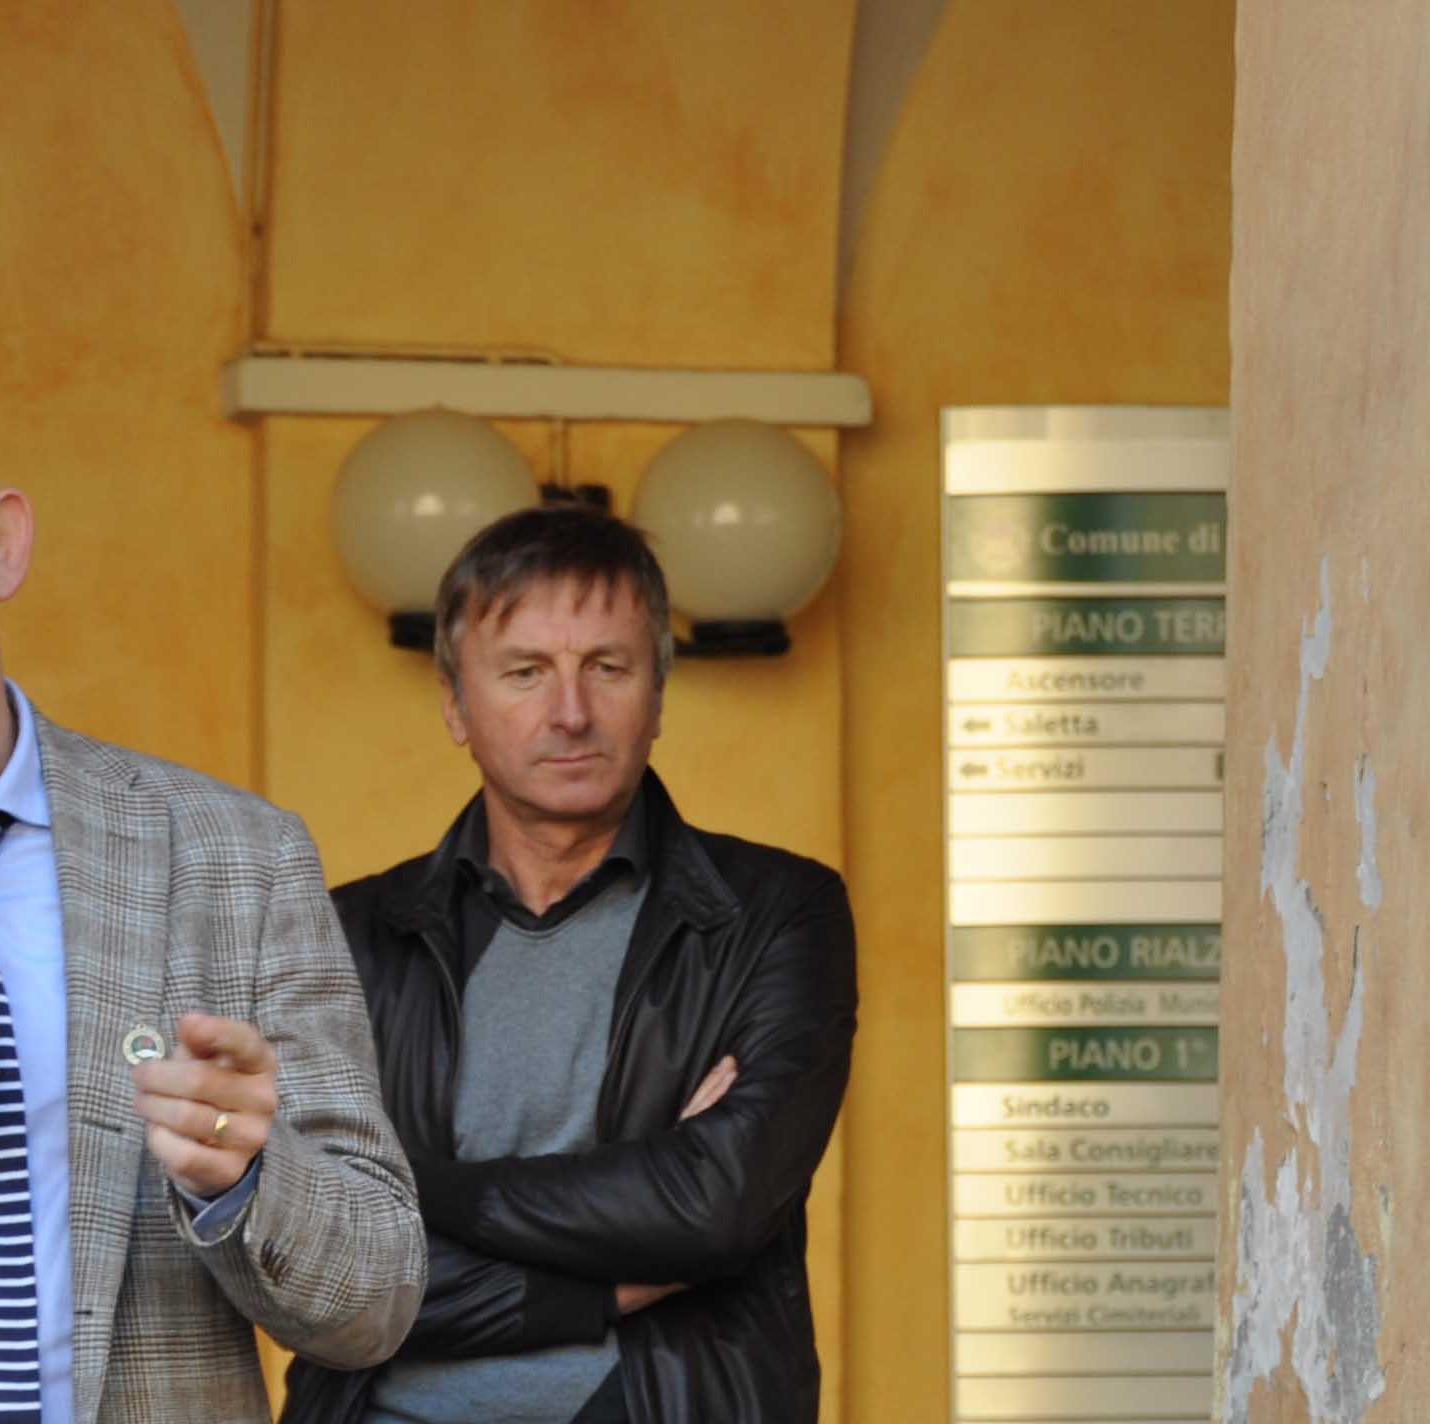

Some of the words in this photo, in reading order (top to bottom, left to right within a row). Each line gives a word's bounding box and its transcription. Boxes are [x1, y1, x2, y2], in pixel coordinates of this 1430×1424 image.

[1041, 523, 1179, 555] Comune
[1188, 521, 1220, 553] di
[1032, 610, 1144, 643] PIANO
[1007, 670, 1144, 691] Ascensore
[1006, 715, 1099, 735] Saletta
[997, 757, 1085, 781] Servizi
[1010, 936, 1119, 968] PIANO
[1048, 1039, 1161, 1071] PIANO
[1003, 1096, 1111, 1119] Sindaco
[1004, 1138, 1061, 1163] Sala
[1006, 1185, 1097, 1206] Ufficio
[1107, 1184, 1203, 1206] Tecnico
[1007, 1229, 1097, 1250] Ufficio
[1110, 1227, 1194, 1249] Tributi
[1007, 1273, 1099, 1295] Ufficio
